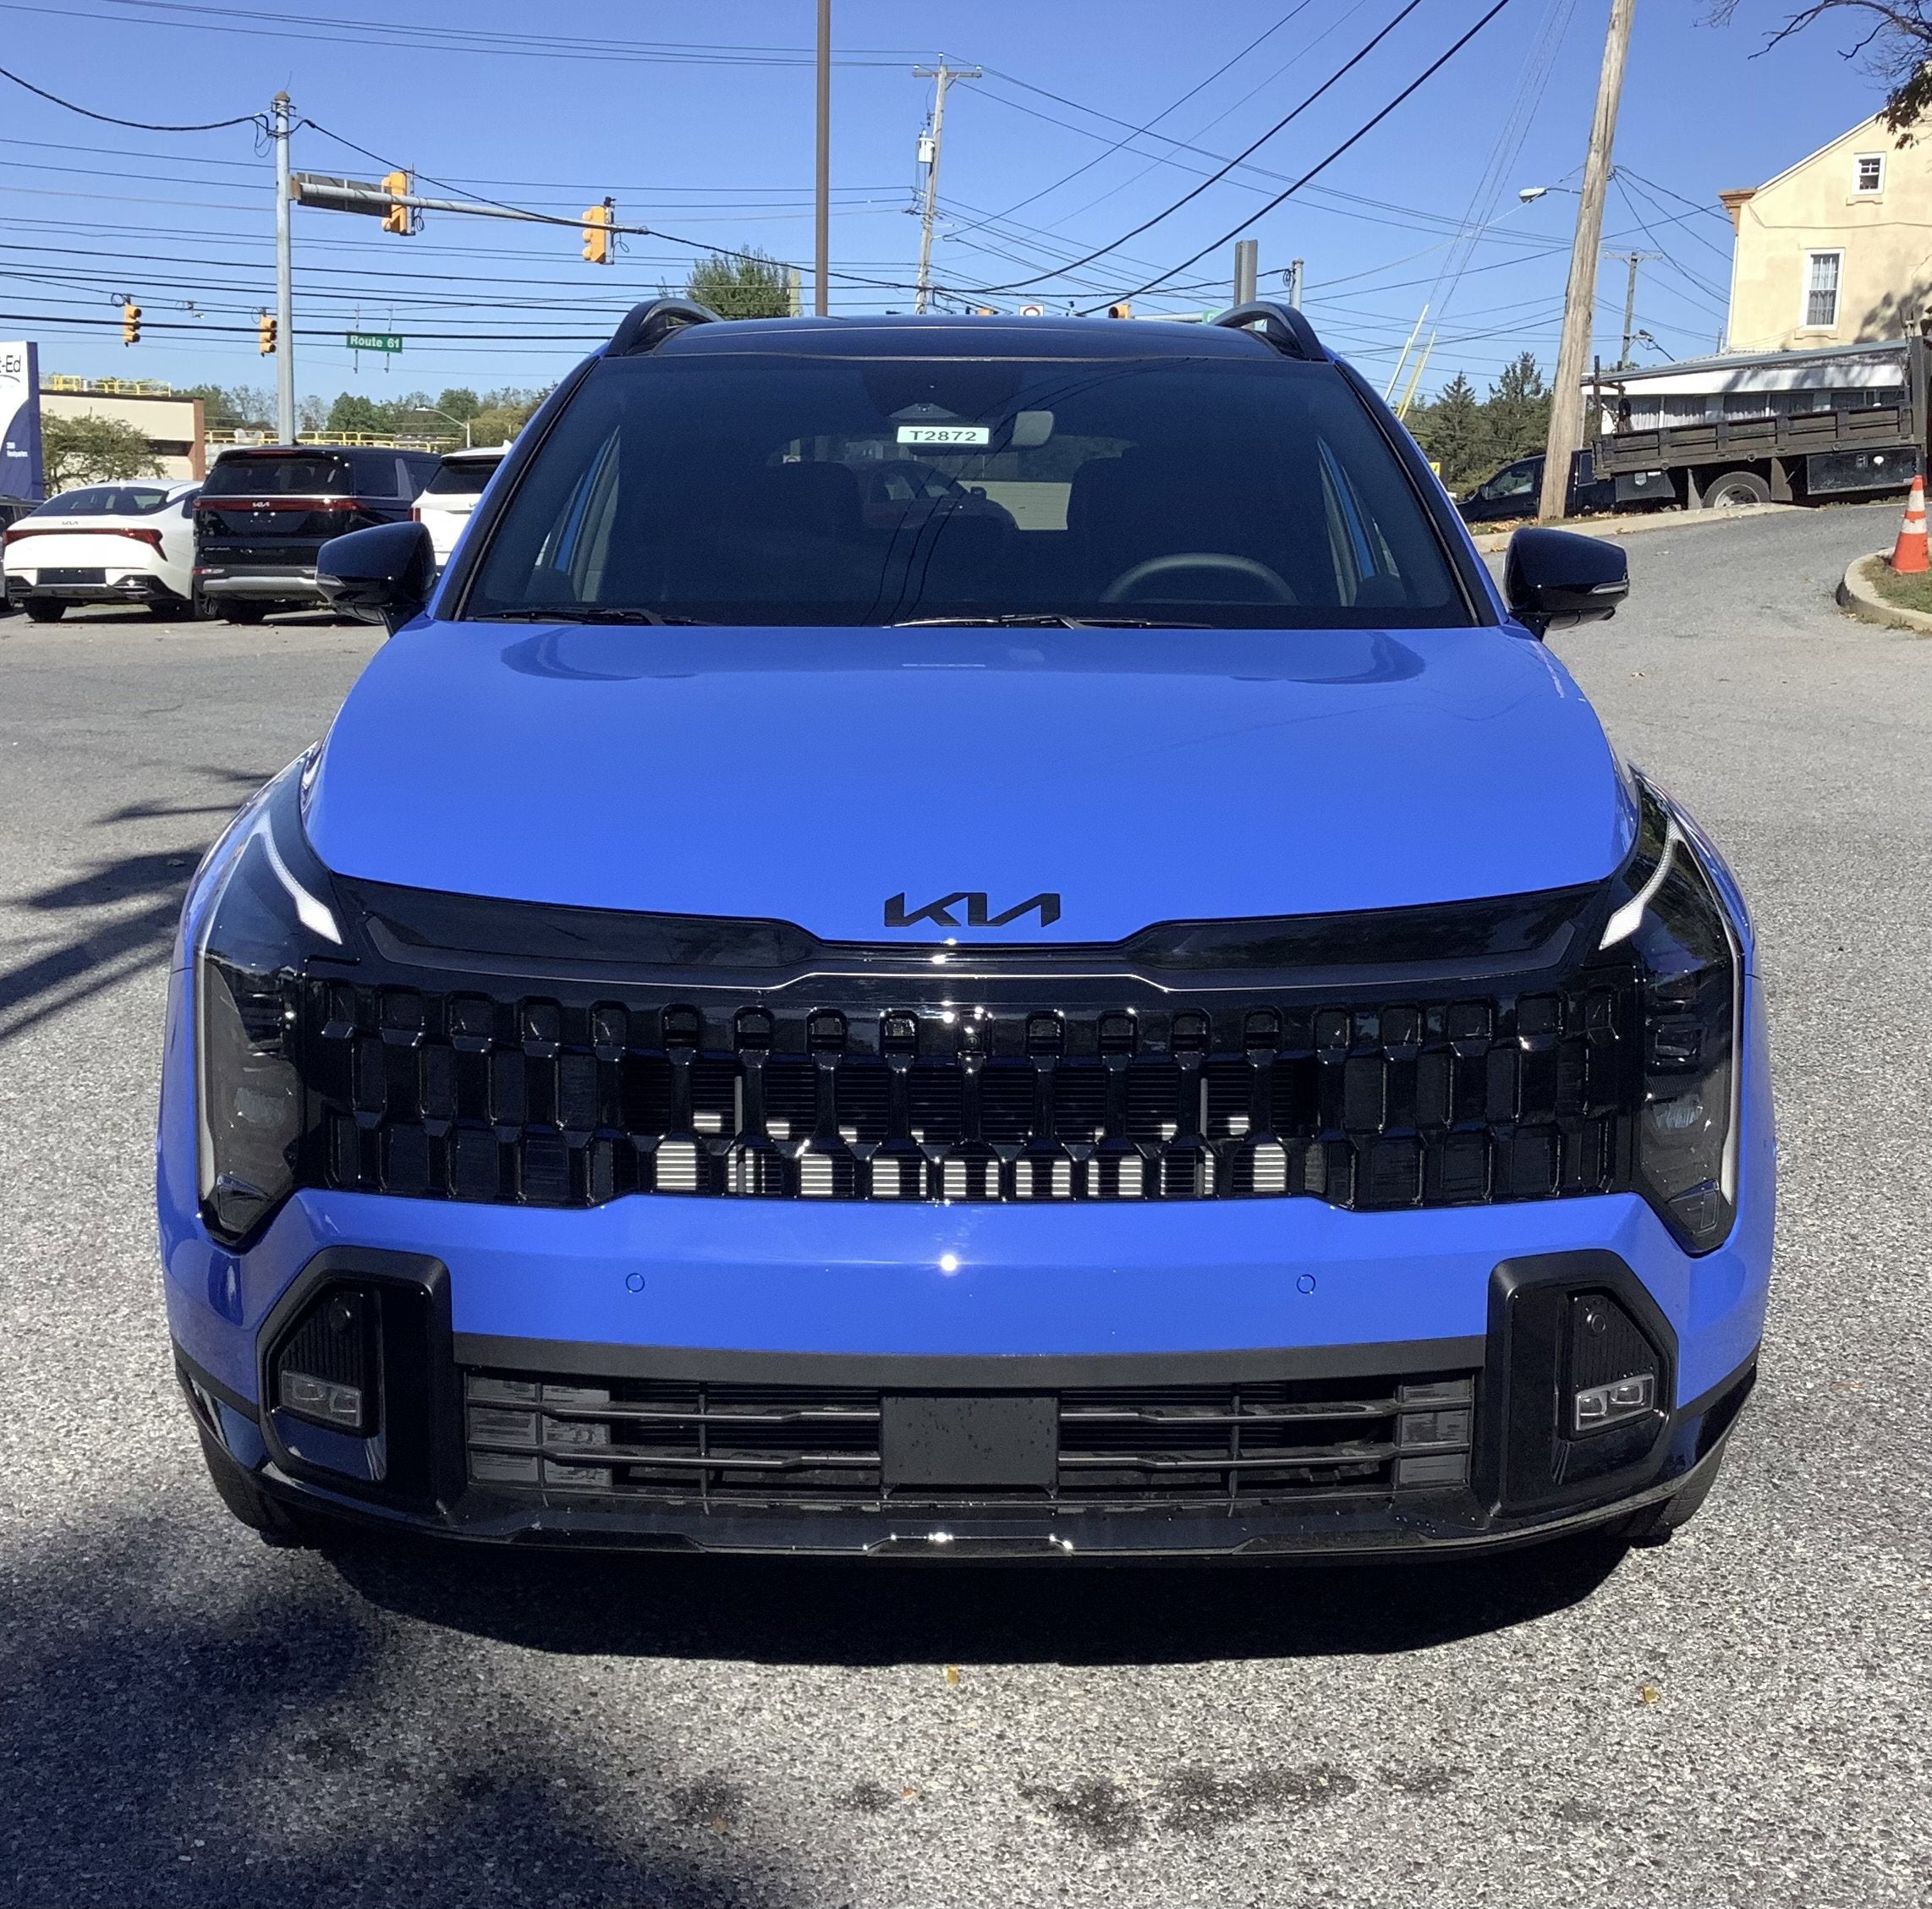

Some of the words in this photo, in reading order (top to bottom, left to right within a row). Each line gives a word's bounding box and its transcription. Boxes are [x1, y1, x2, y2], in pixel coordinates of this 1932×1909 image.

[349, 335, 383, 348] Route
[387, 338, 400, 348] 61
[909, 431, 977, 442] T2872
[884, 891, 1061, 928] KIA
